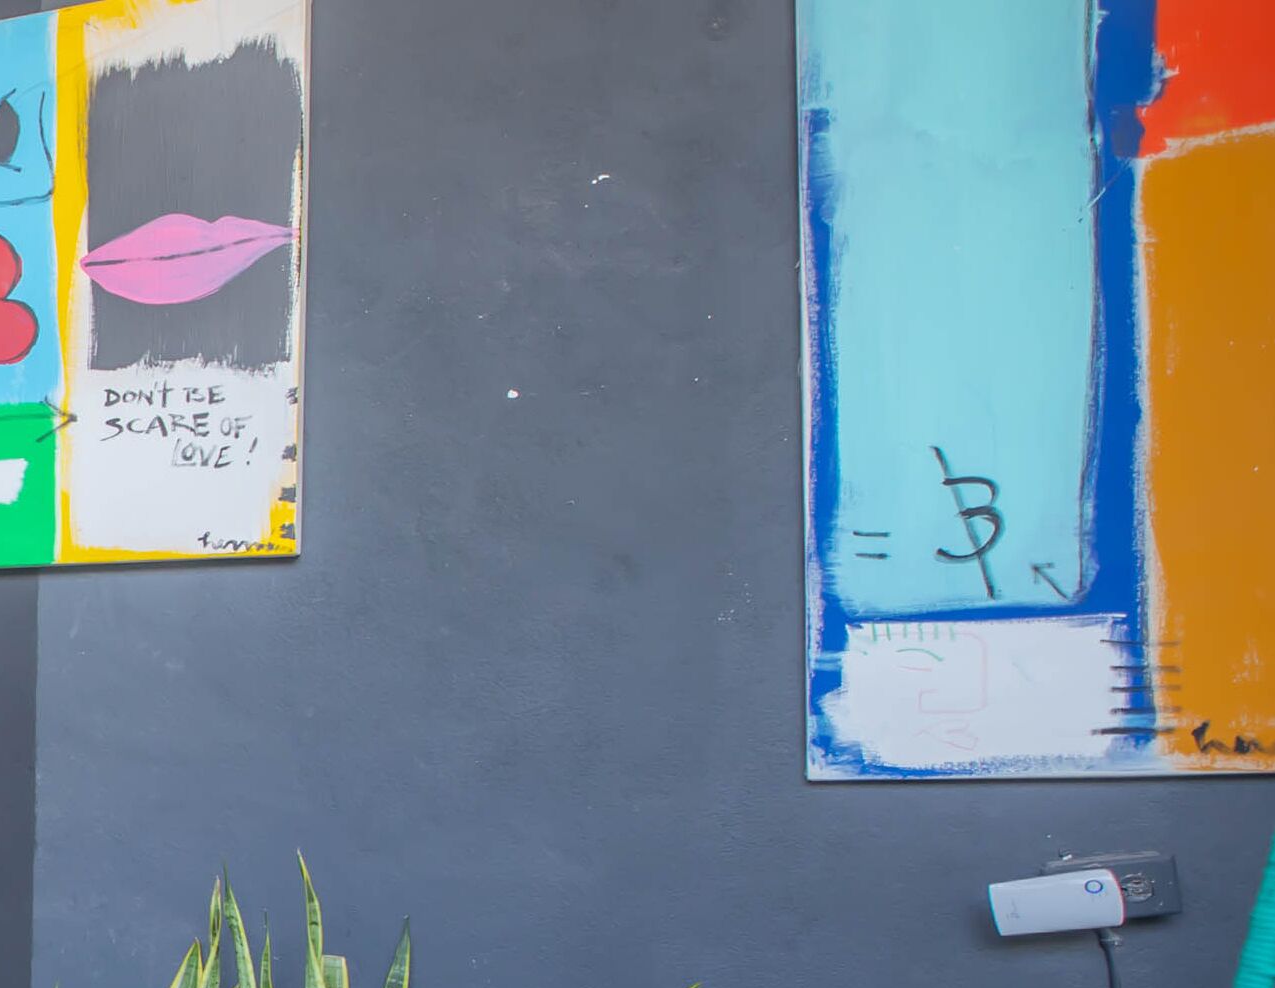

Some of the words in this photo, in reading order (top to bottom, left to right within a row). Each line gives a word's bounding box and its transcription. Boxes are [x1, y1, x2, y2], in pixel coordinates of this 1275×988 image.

[183, 385, 226, 404] BE
[100, 412, 210, 441] SCARE
[220, 415, 252, 439] OF
